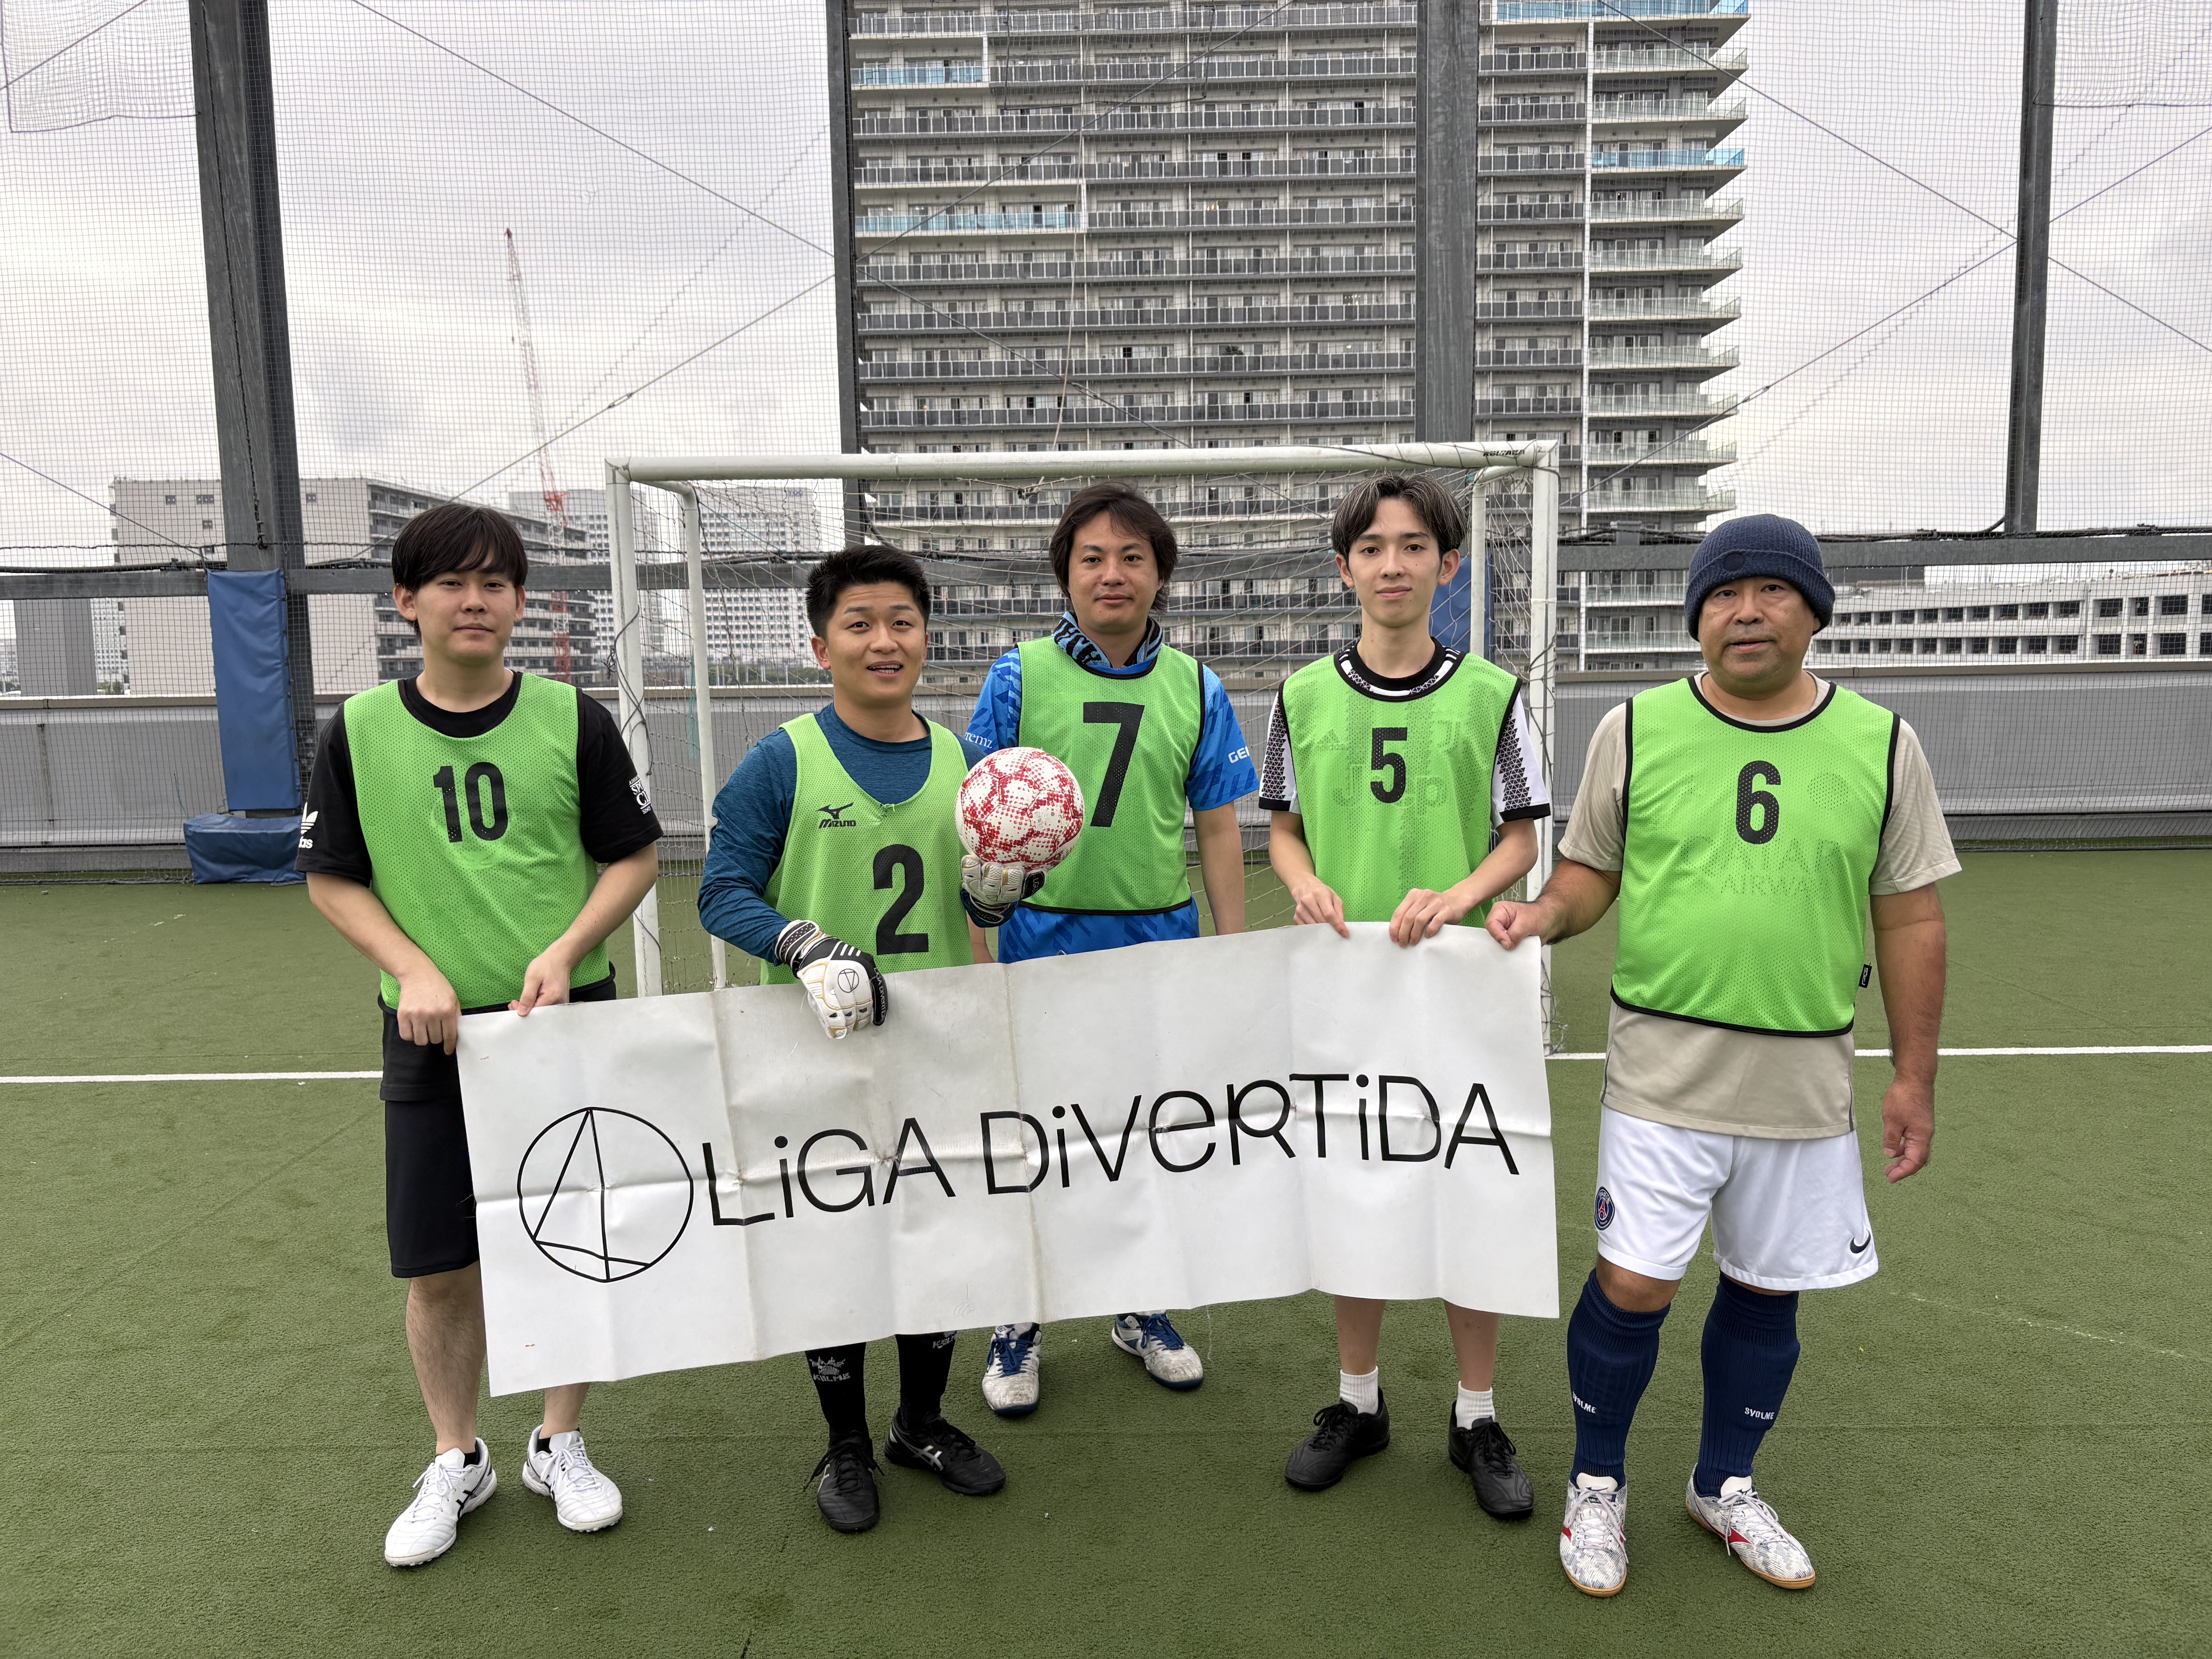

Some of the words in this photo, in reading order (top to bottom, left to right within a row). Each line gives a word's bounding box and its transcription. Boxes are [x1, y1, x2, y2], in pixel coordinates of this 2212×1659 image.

[433, 761, 508, 842] 10
[1083, 701, 1145, 827] 7
[1370, 727, 1408, 804] 5
[1736, 761, 1781, 844] 6
[819, 819, 857, 829] MIZUNO
[872, 843, 929, 955] 2
[1599, 1191, 1610, 1204] PARIS
[1745, 1407, 1774, 1420] SVOLME
